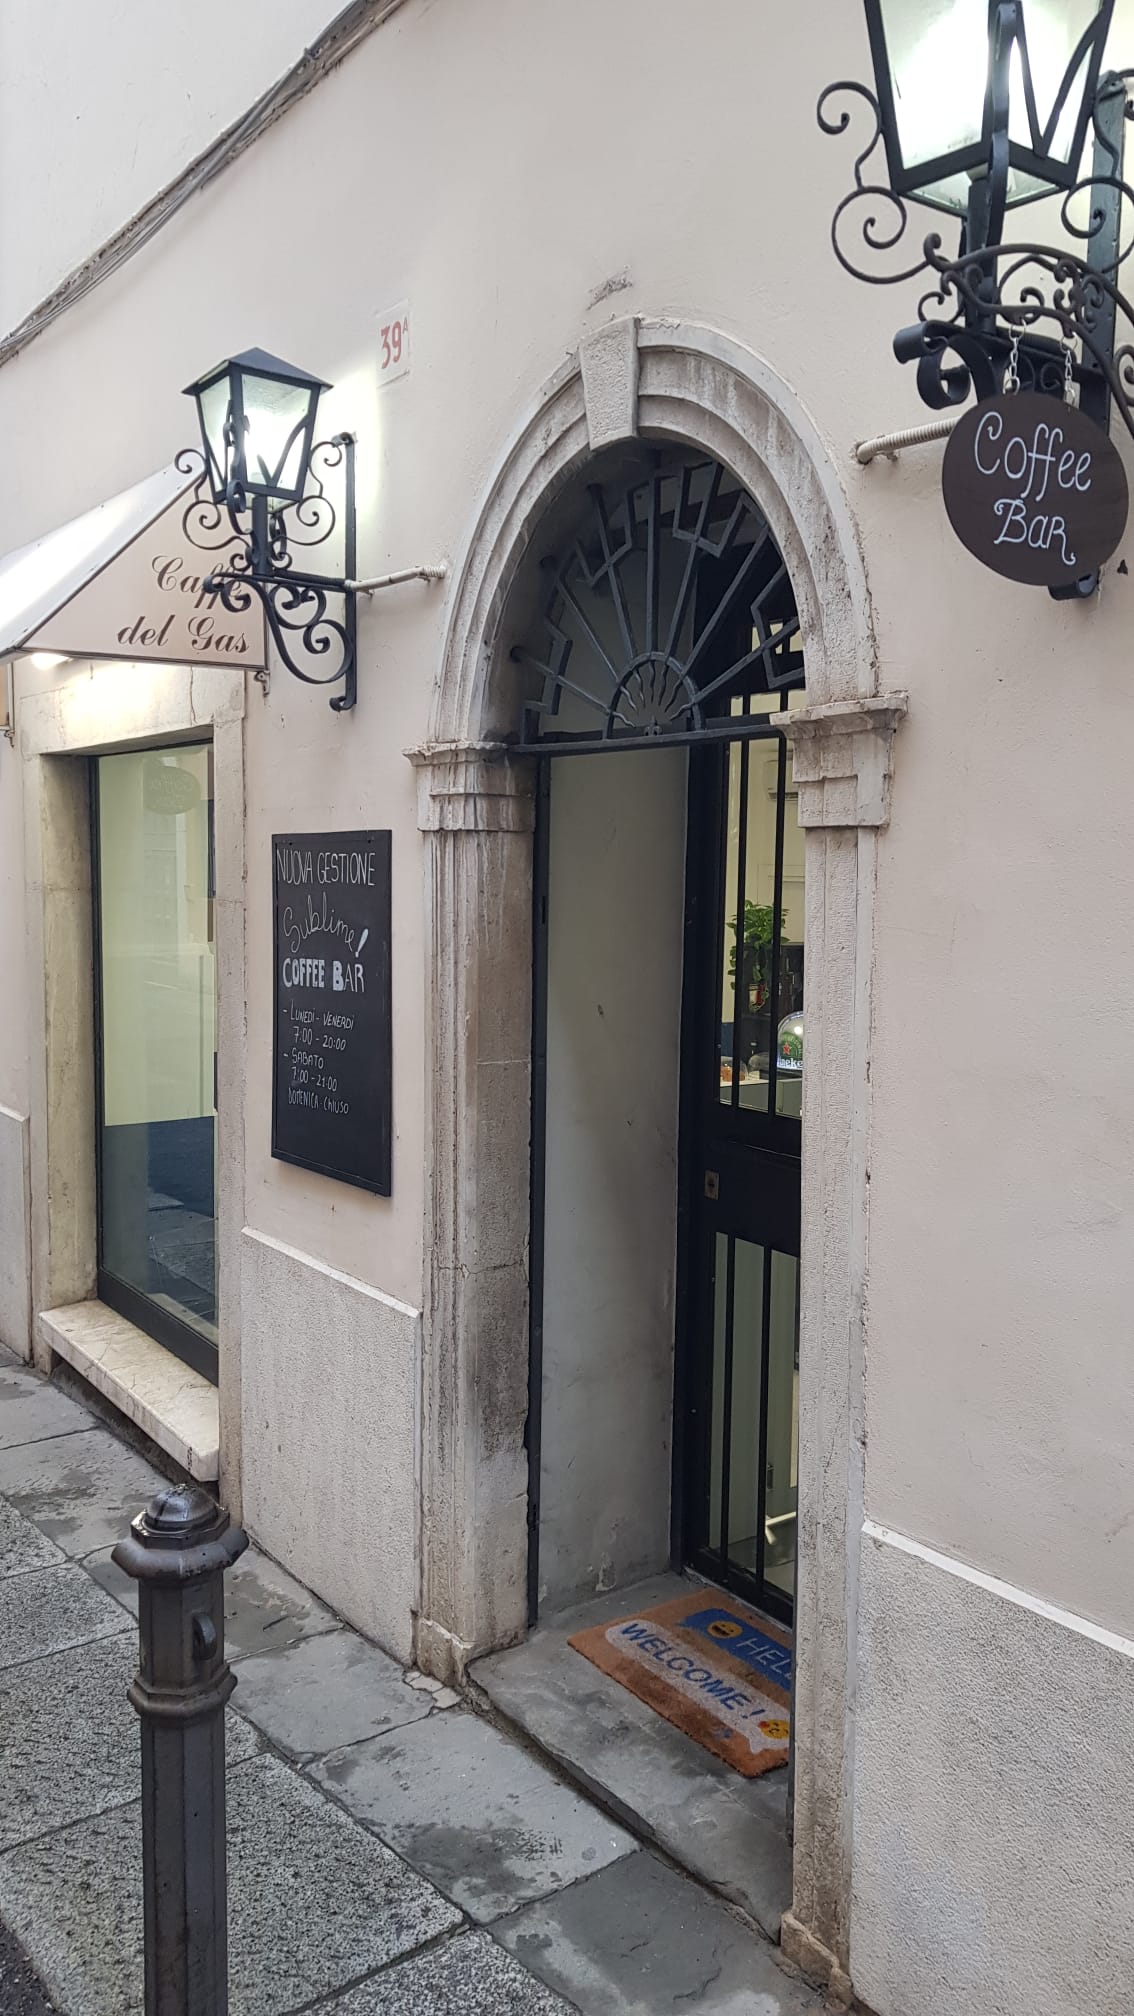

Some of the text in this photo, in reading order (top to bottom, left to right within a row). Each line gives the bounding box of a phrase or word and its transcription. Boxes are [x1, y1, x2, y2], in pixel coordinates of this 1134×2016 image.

[974, 411, 1091, 501] Coffee
[117, 614, 249, 653] del Gas
[276, 849, 376, 886] NUOVA GESTIONE
[282, 958, 365, 993] COFFEE BAR
[293, 1026, 313, 1045] 7:00
[322, 1034, 346, 1051] 20:00
[291, 1047, 324, 1069] SABATO
[291, 1066, 309, 1083] 7:00
